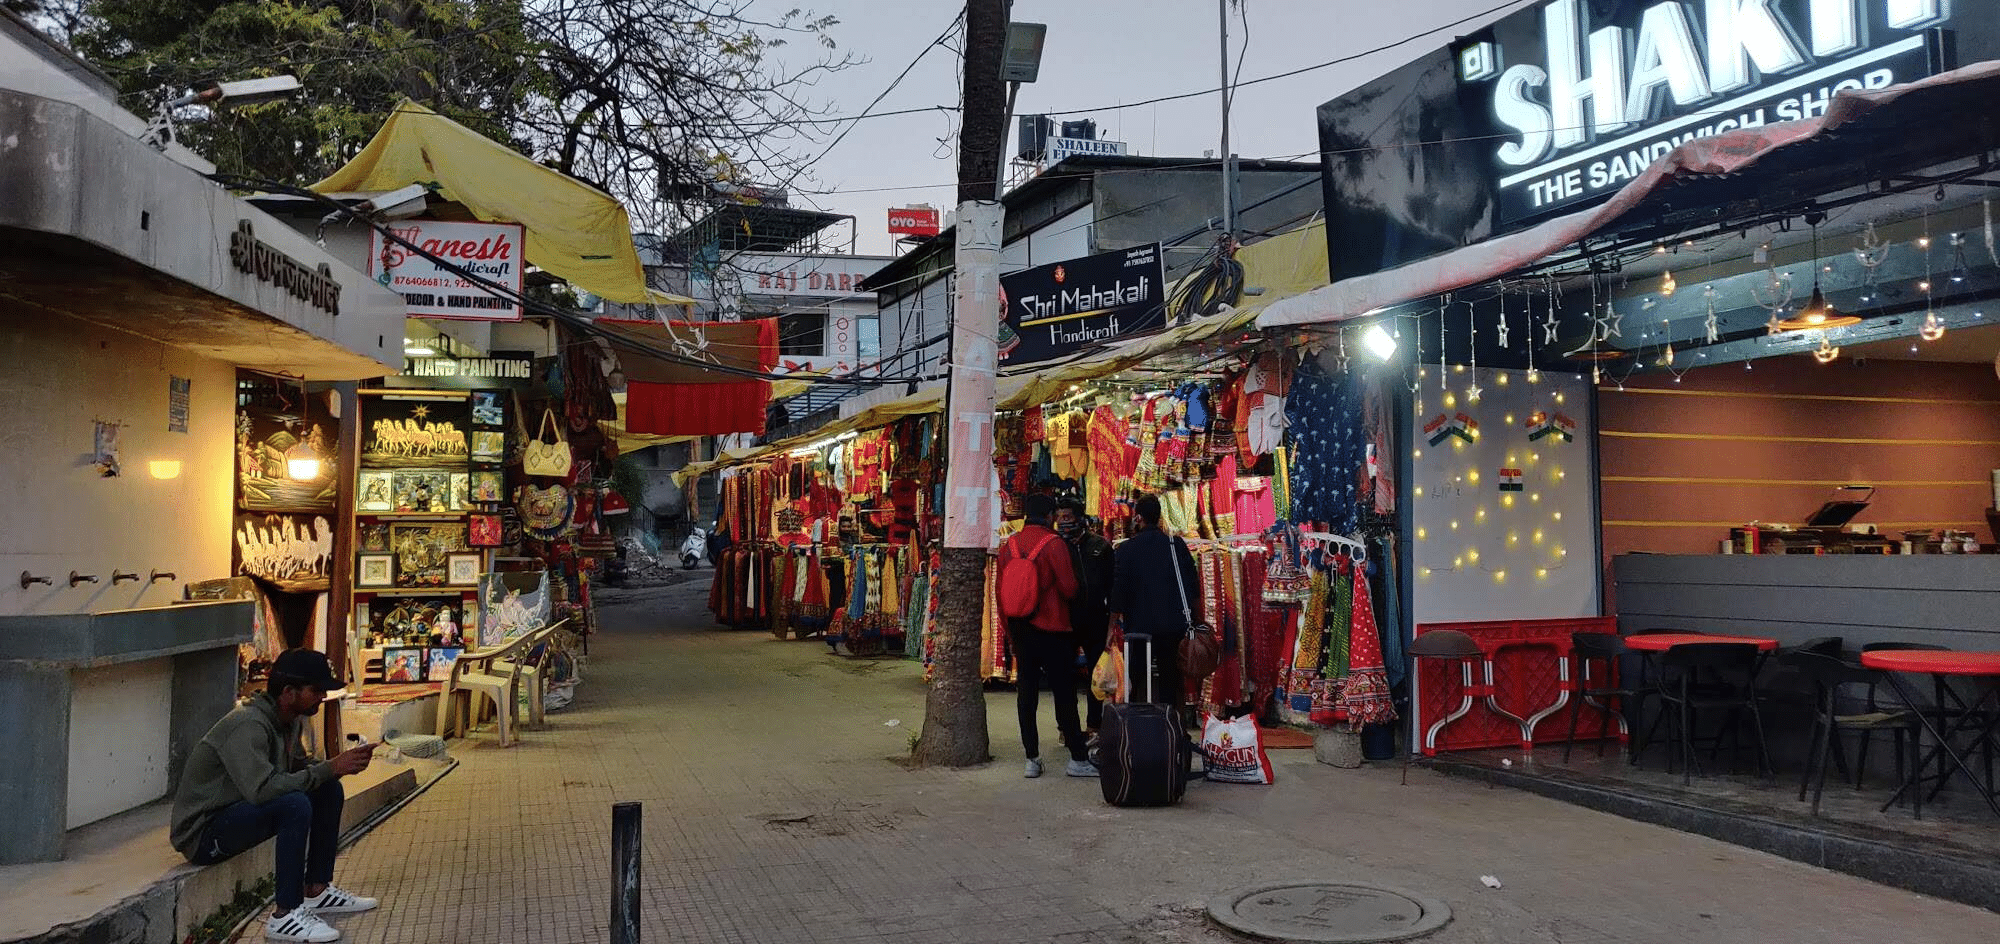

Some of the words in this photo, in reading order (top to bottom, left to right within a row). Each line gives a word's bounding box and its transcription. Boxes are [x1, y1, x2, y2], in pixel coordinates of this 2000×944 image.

[1495, 0, 1941, 166] SHAK
[1057, 139, 1118, 154] SHALEEN
[1528, 175, 1583, 207] THE
[890, 217, 916, 228] OYO
[759, 271, 797, 291] RAJ
[406, 294, 434, 306] DECOR
[437, 297, 445, 307] &
[448, 295, 472, 308] HAND
[473, 296, 513, 310] PAINTING
[1020, 294, 1056, 322] Shri
[1061, 275, 1148, 315] Mahakali
[1050, 314, 1119, 345] Handicraft
[414, 358, 456, 376] HAND
[460, 359, 530, 378] PAINTING
